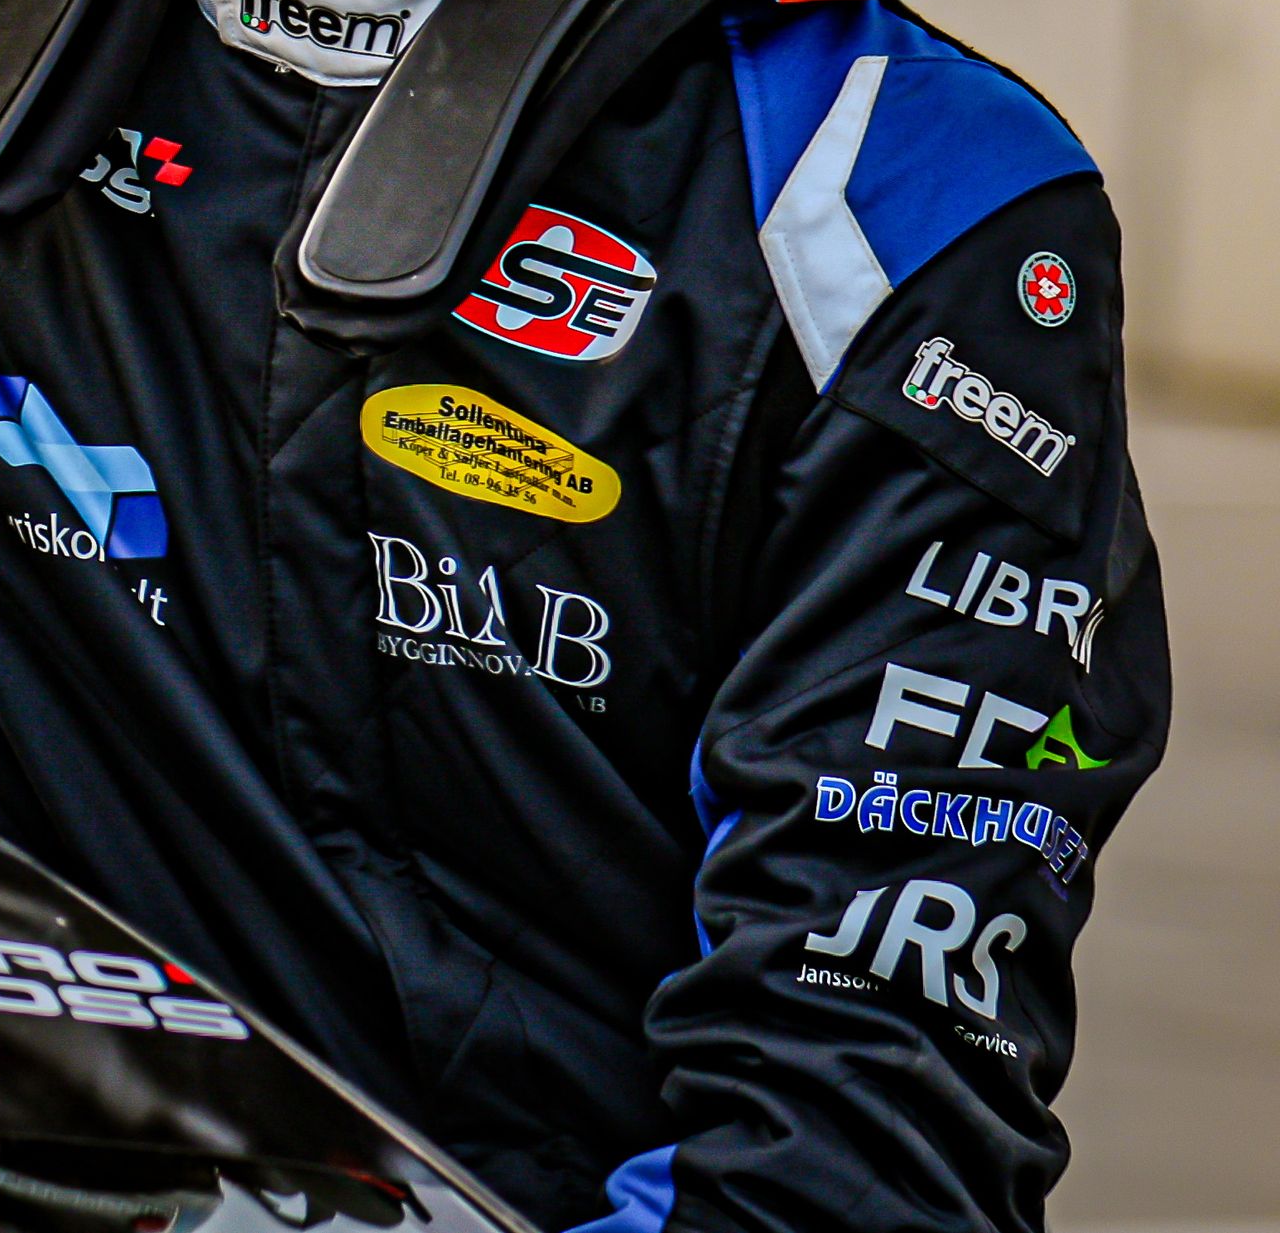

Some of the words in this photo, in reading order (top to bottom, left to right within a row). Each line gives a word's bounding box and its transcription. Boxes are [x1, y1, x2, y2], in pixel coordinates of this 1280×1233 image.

[439, 395, 548, 456] Sollentuna
[902, 336, 1077, 478] freem
[439, 465, 461, 483] Tel.
[566, 473, 594, 495] AB
[804, 878, 1028, 1021] JRS
